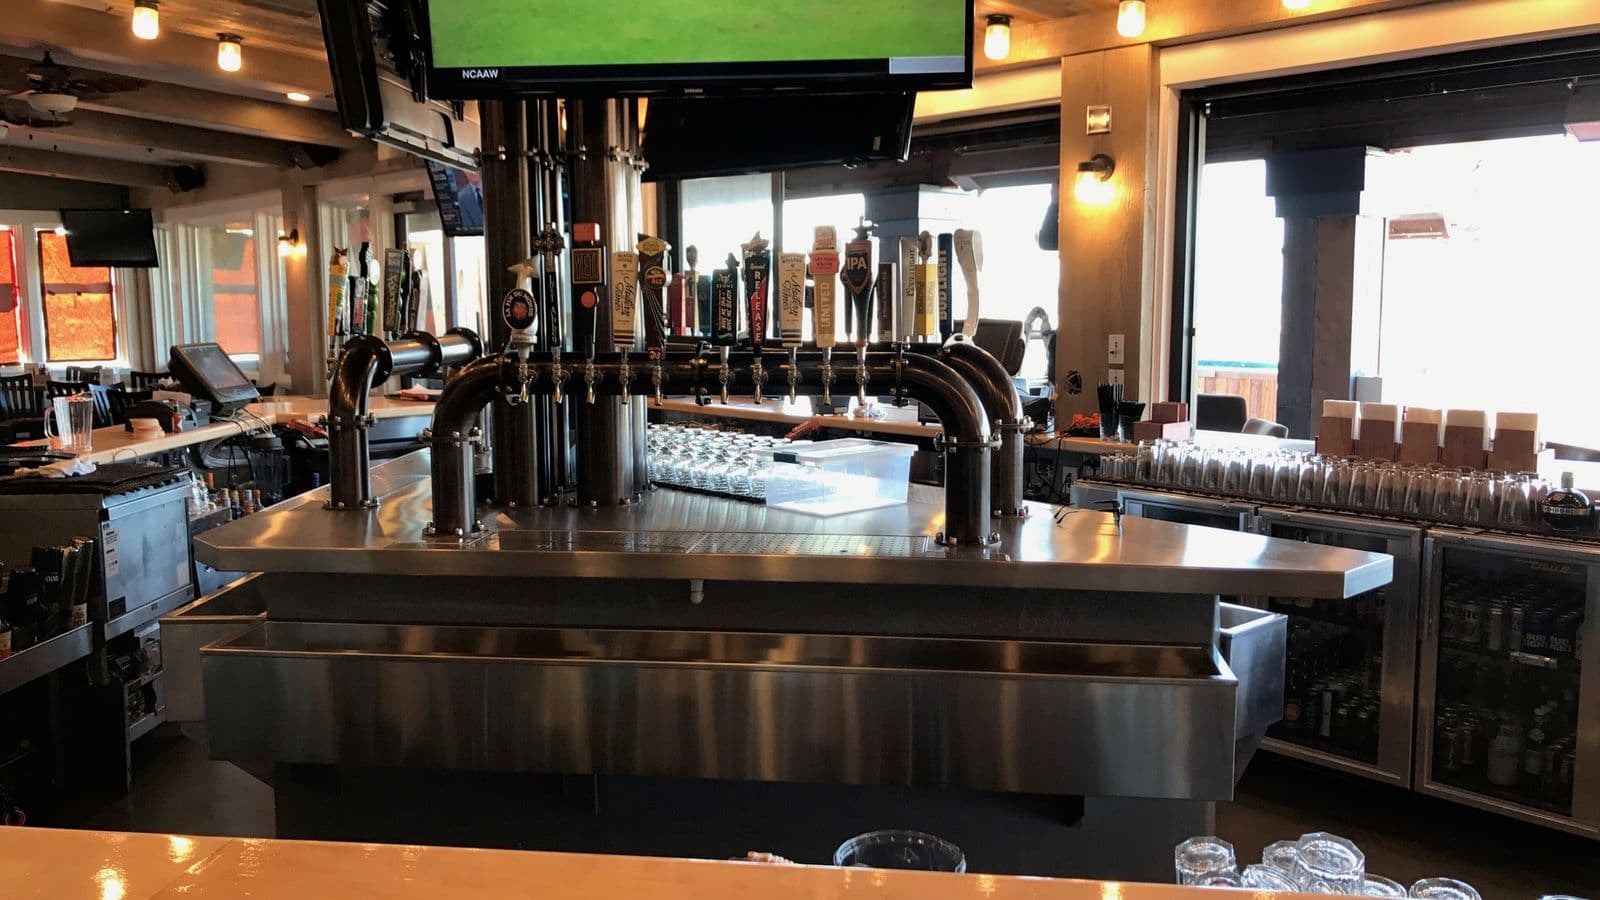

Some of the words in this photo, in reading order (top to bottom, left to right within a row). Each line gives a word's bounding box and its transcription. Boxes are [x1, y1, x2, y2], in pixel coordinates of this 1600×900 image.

[462, 69, 499, 79] NCAAW
[847, 257, 867, 270] IPA
[937, 250, 948, 289] LIGHT
[506, 295, 514, 307] FIN
[754, 271, 762, 341] RELEASE
[820, 282, 831, 328] LIMITED
[938, 290, 948, 320] BUD
[505, 307, 511, 317] LA
